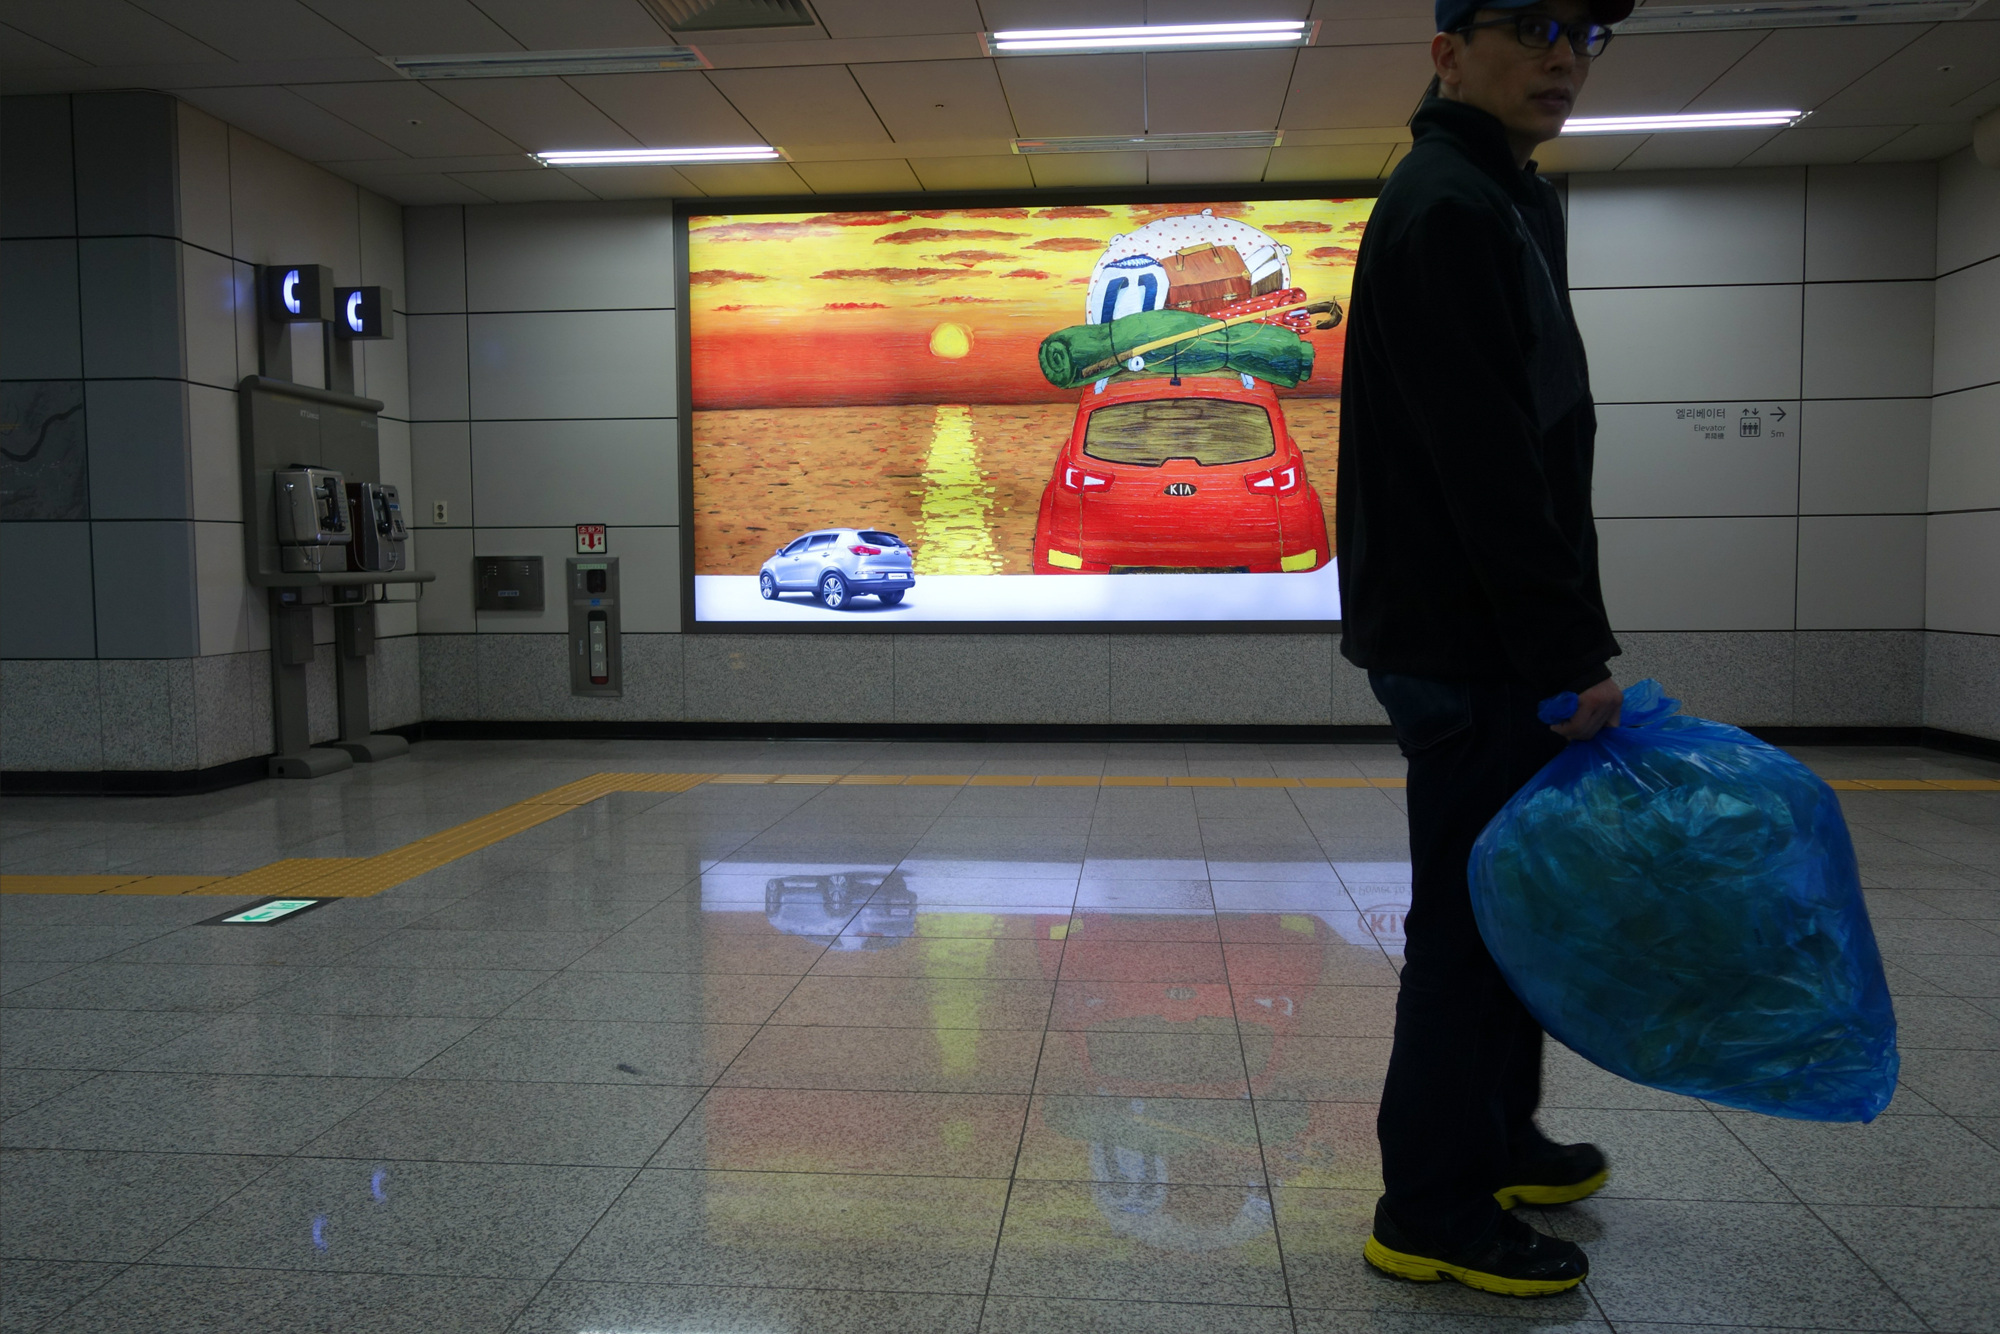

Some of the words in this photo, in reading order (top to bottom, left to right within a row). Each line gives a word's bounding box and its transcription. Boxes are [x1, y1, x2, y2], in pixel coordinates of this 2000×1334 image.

[1675, 408, 1726, 420] 엘리베이터
[1693, 424, 1726, 432] Elevator
[1770, 430, 1785, 438] 5m
[1170, 483, 1192, 495] KIA
[593, 625, 604, 672] 소화기
